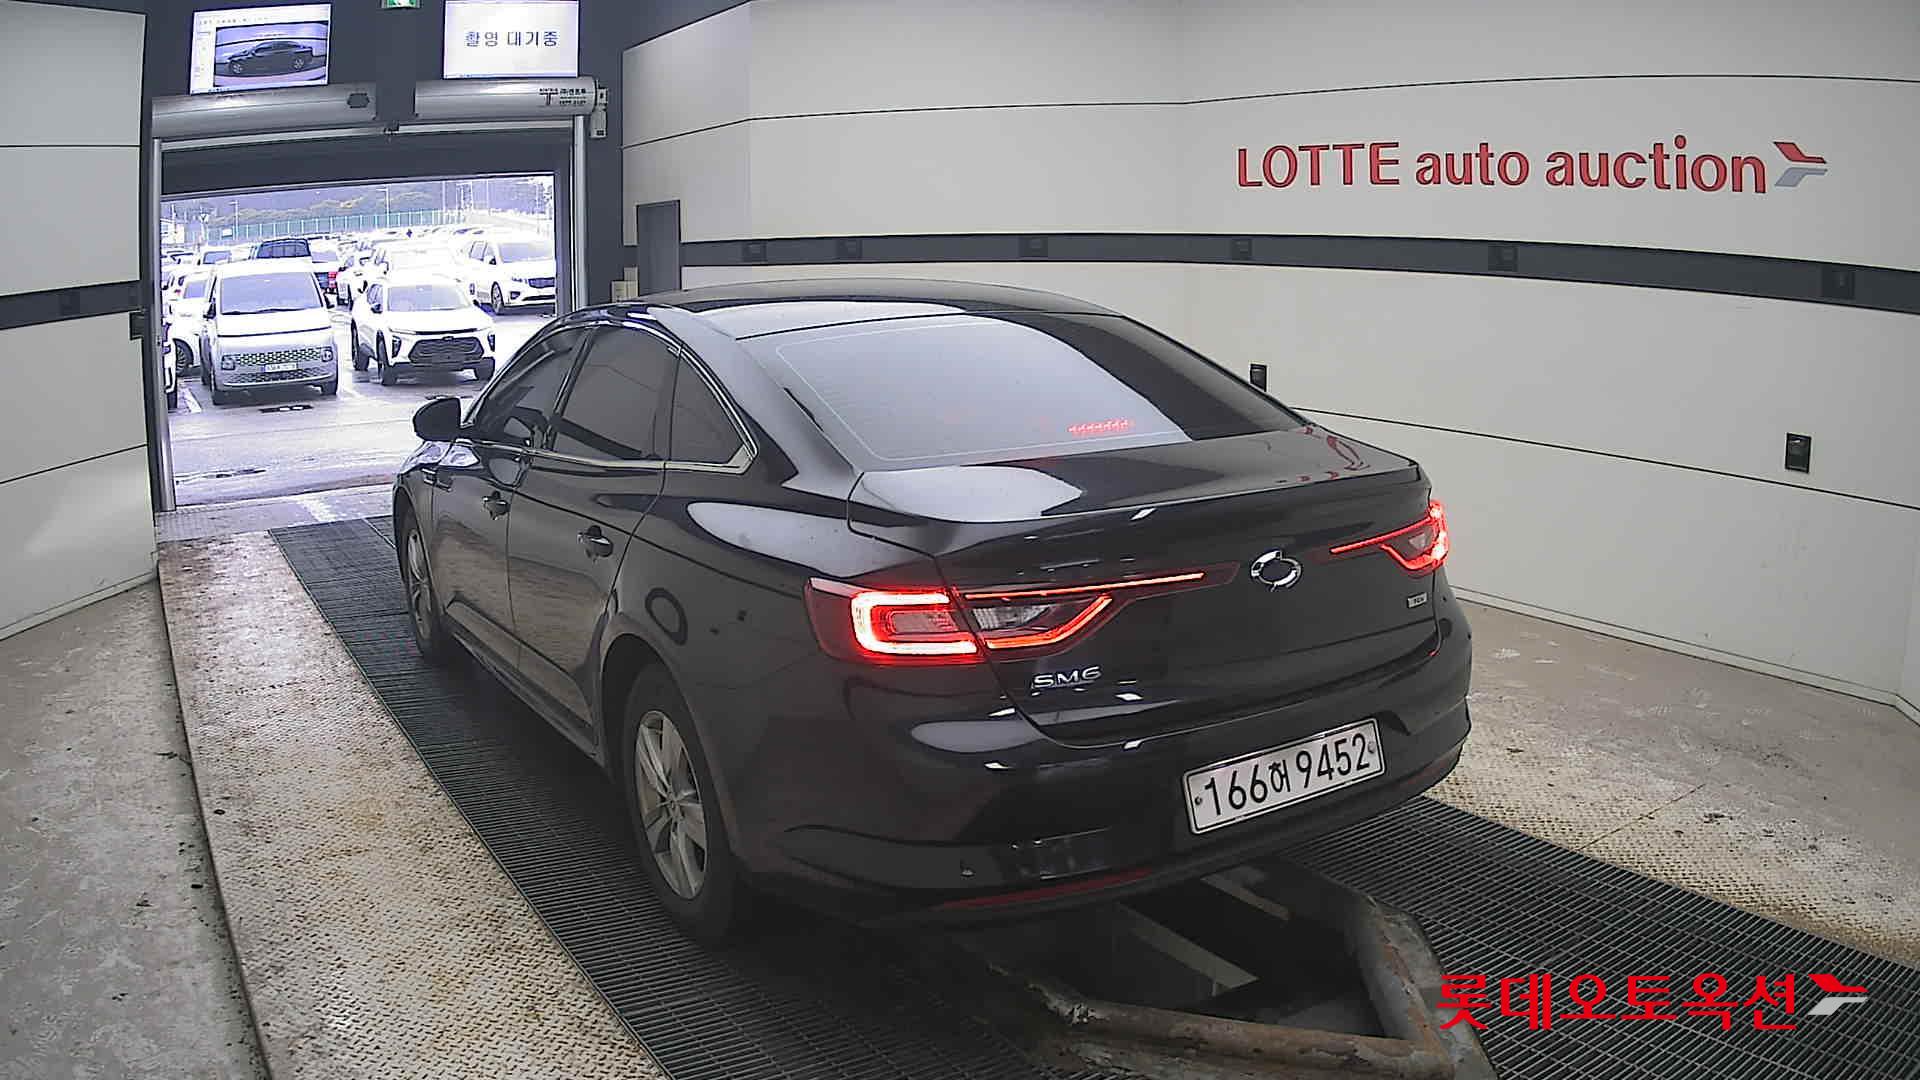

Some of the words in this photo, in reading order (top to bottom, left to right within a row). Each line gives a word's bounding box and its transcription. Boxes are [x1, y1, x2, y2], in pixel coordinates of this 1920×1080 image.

[507, 31, 560, 47] 대기중
[1237, 142, 1400, 188] LOTTE
[1415, 142, 1531, 186] auto
[1545, 134, 1767, 194] auction
[1033, 665, 1102, 688] SM6
